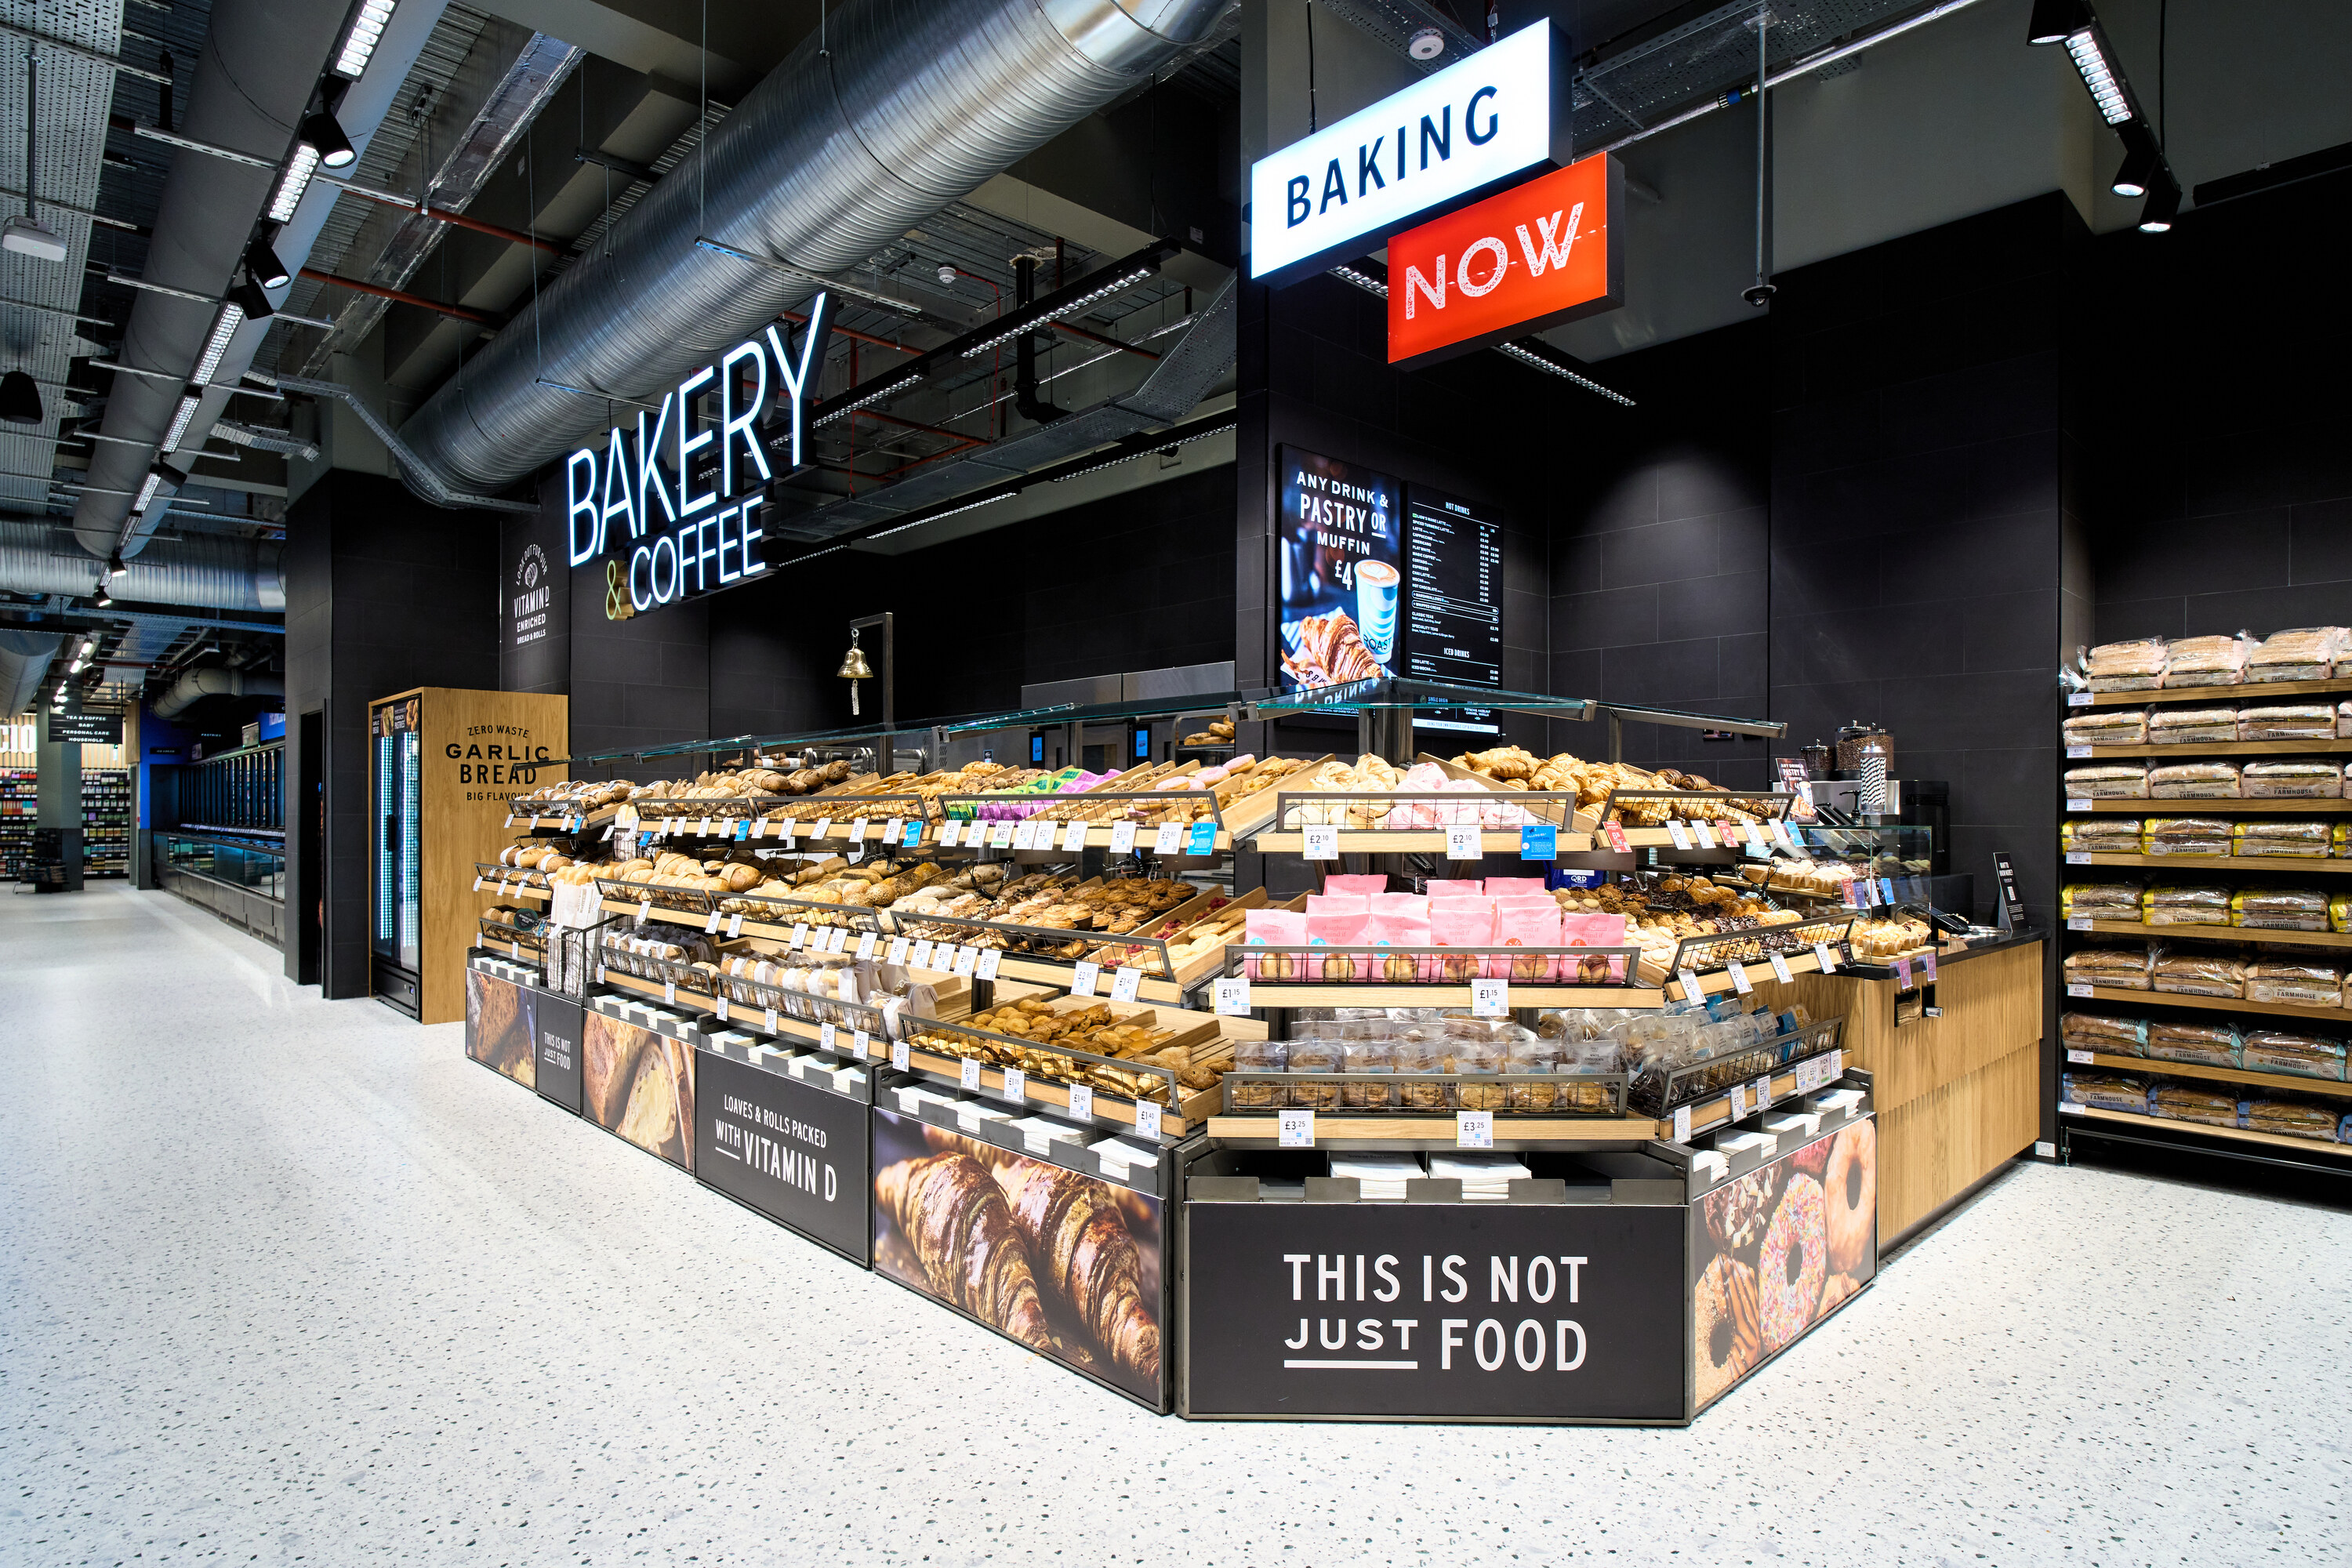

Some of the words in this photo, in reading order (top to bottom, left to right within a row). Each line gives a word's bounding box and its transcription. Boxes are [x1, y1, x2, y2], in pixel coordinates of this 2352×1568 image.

[1287, 85, 1498, 229] BAKING
[1405, 201, 1584, 320] NOW
[568, 291, 826, 568] BAKERY
[1296, 470, 1327, 492] ANY
[1331, 480, 1376, 505] DRINK
[1379, 493, 1388, 508] &
[1300, 492, 1367, 534] PASTRY
[1371, 512, 1386, 532] OR
[1445, 502, 1454, 511] HOT
[1454, 504, 1470, 516] DRINKS
[1316, 531, 1370, 556] MUFFIN
[1412, 532, 1433, 541] CAPPUCCINO
[1412, 539, 1432, 547] AMERICANO
[515, 556, 525, 586] LOOK
[524, 544, 532, 561] OUT
[532, 543, 541, 559] FOR
[539, 552, 548, 575] OUR
[605, 559, 622, 620] &
[630, 495, 766, 612] COFFEE
[1334, 559, 1352, 591] £4
[514, 586, 544, 619] VITAMIN
[545, 586, 550, 604] D
[517, 613, 546, 633] ENRICHED
[517, 633, 530, 644] BREAD
[529, 632, 533, 641] &
[532, 629, 546, 640] ROLLS
[1363, 633, 1392, 651] ROAST
[1443, 647, 1454, 656] ICED
[1454, 648, 1470, 659] DRINKS
[467, 724, 493, 736] ZERO
[496, 724, 529, 739] WASTE
[445, 743, 550, 760] GARLIC
[460, 764, 537, 785] BREAD
[466, 792, 484, 801] BIG
[997, 830, 1008, 839] ME!
[1309, 834, 1329, 844] £2.10
[1453, 834, 1472, 844] £2.10
[1570, 875, 1587, 884] QRD
[518, 913, 535, 924] REMARKABLE
[1221, 989, 1240, 998] £1.15
[1479, 989, 1498, 999] £1.15
[2277, 990, 2317, 1000] FARMHOUSE
[543, 1031, 555, 1047] THIS
[555, 1036, 561, 1050] IS
[561, 1038, 571, 1054] NOT
[544, 1047, 557, 1060] JUST
[557, 1051, 571, 1070] FOOD
[2175, 1051, 2211, 1061] FARMHOUSE
[2270, 1058, 2310, 1070] FARMHOUSE
[724, 1094, 753, 1120] LOAVES
[754, 1105, 761, 1123] &
[763, 1108, 790, 1134] ROLLS
[792, 1119, 827, 1149] PACKED
[1285, 1120, 1306, 1130] £3.25
[1464, 1122, 1485, 1131] £3.25
[715, 1118, 741, 1149] WITH
[743, 1130, 816, 1196] VITAMIN
[825, 1163, 837, 1203] D
[1283, 1254, 1400, 1302] THIS
[1423, 1254, 1468, 1303] IS
[1490, 1255, 1588, 1304] NOT
[1283, 1318, 1418, 1350] JUST
[1441, 1318, 1587, 1372] FOOD
